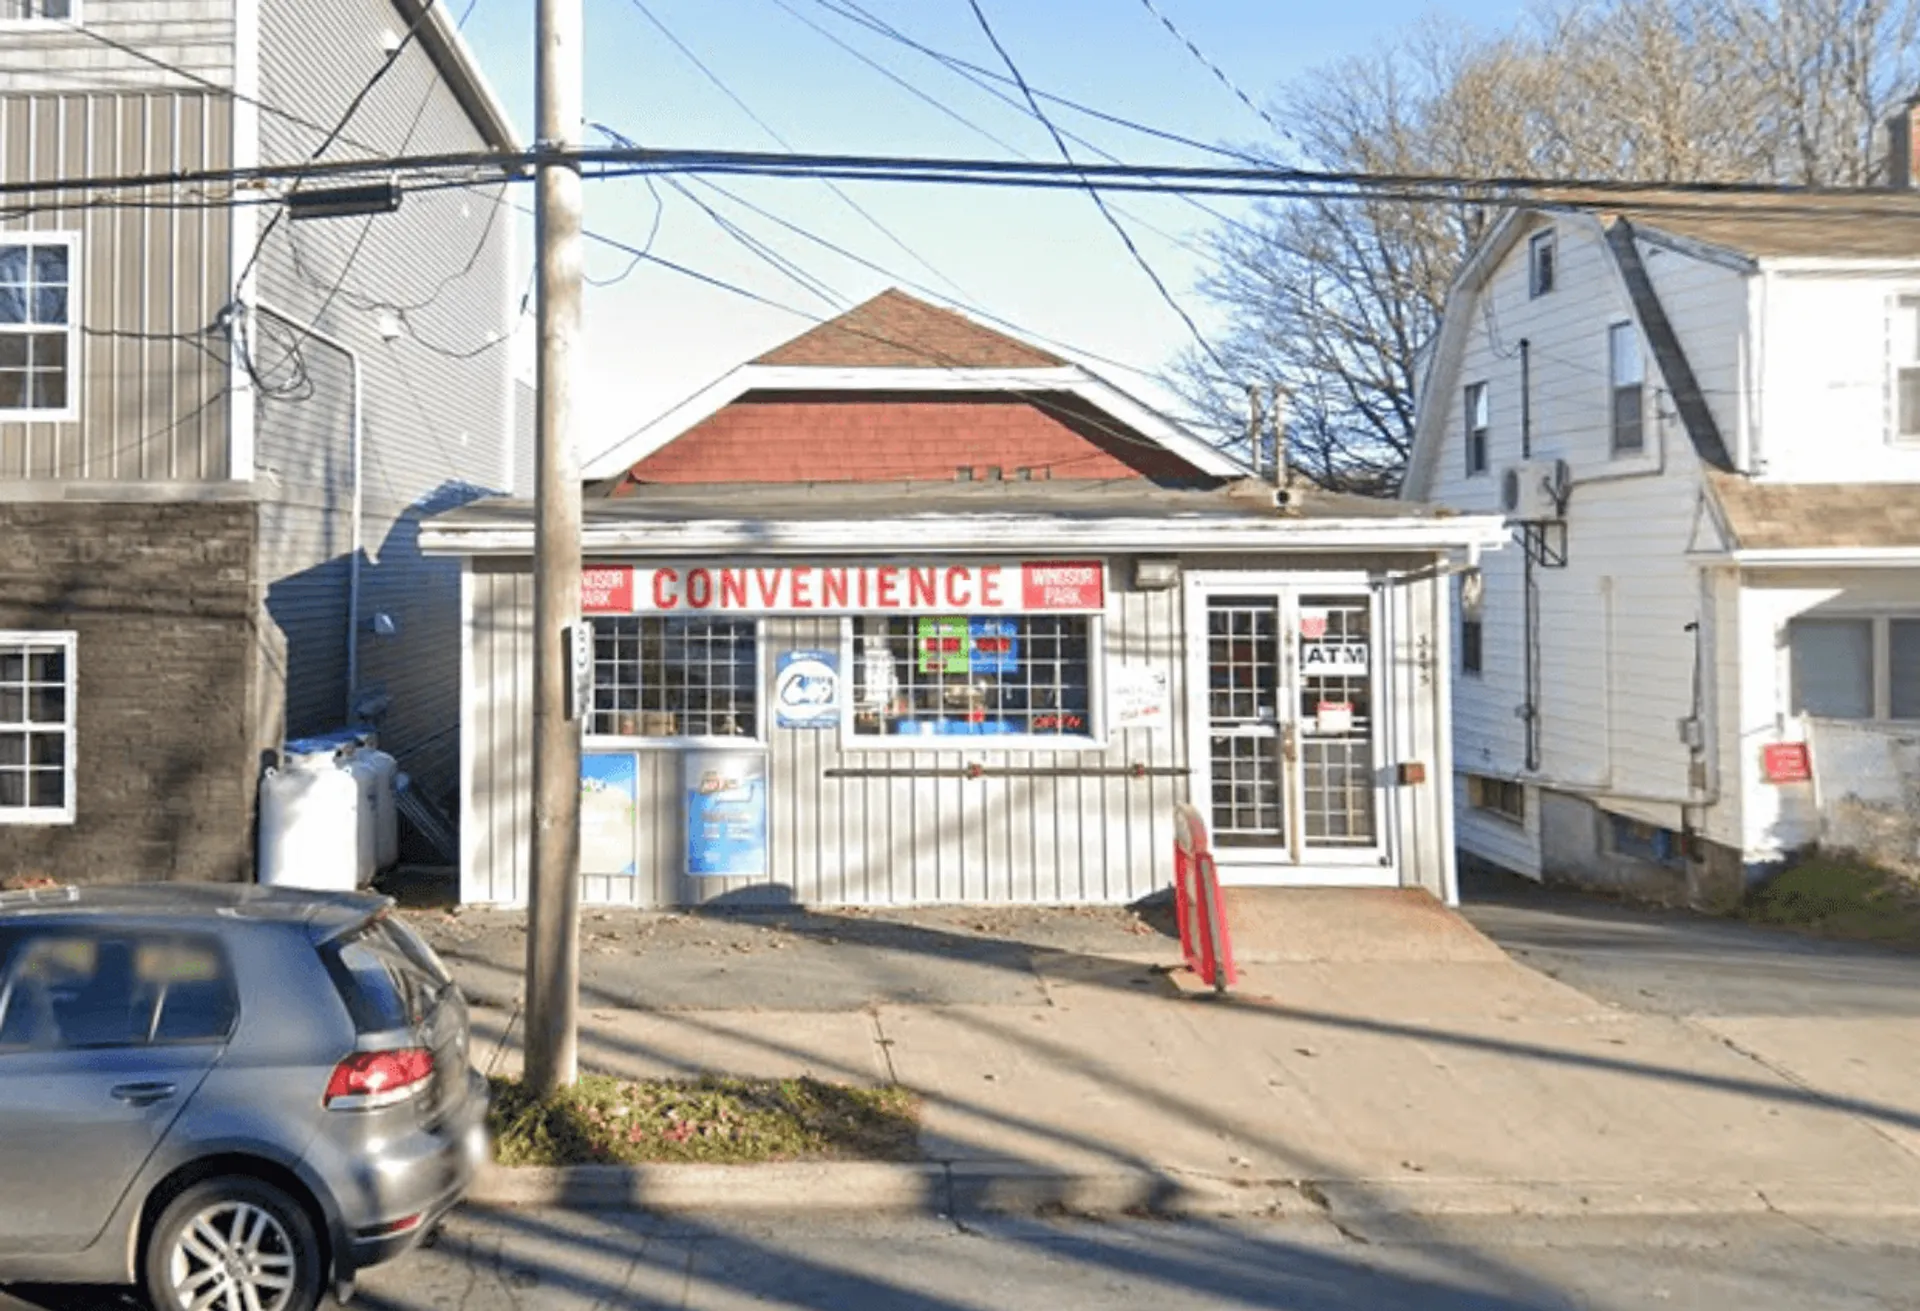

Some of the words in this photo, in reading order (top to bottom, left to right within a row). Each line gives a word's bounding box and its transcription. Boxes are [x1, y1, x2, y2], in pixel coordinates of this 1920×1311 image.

[1032, 568, 1093, 586] WINDSOR
[653, 566, 1004, 609] CONVENIENCE
[1044, 586, 1082, 605] PARK
[582, 589, 610, 606] ARK
[1307, 646, 1366, 664] ATM
